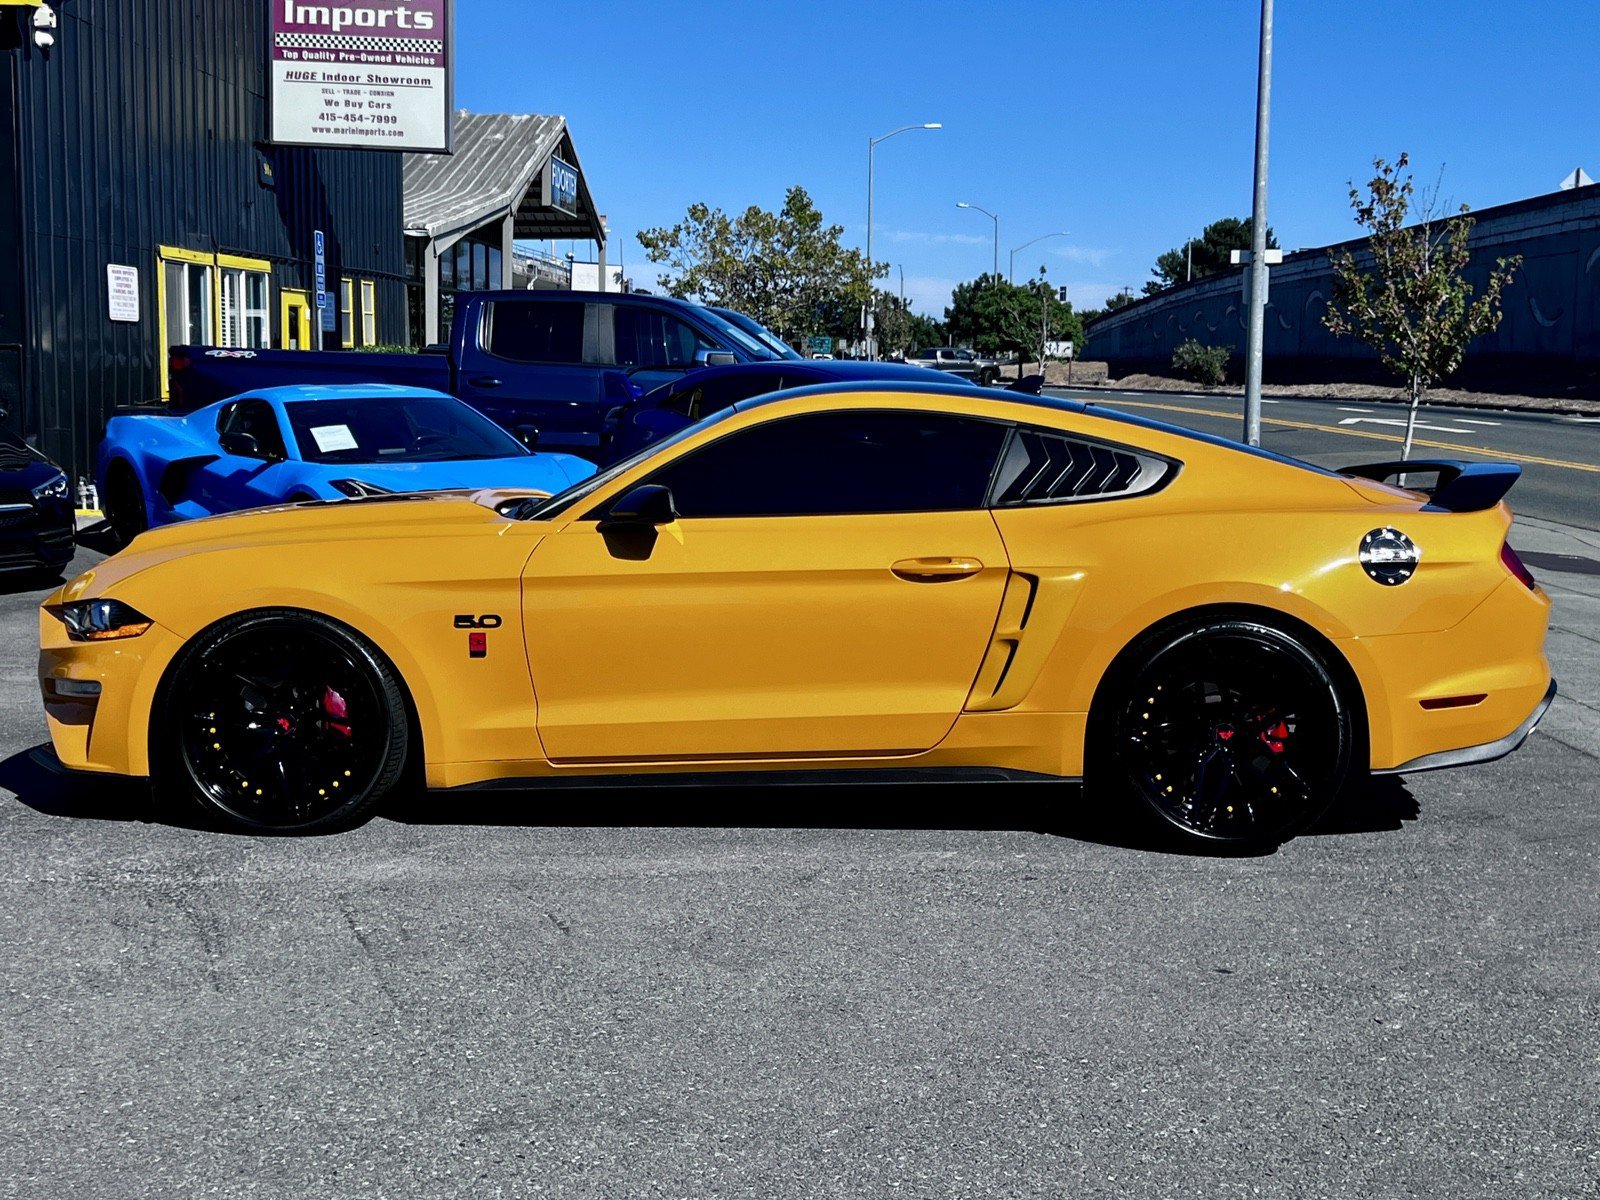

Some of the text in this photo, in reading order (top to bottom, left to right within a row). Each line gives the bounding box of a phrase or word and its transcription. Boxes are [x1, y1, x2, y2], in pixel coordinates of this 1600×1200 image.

[284, 0, 434, 32] Imports
[282, 50, 435, 66] Top Quality Pre-Owned Vehicles
[285, 71, 432, 86] HUGE Indoor Showroom
[324, 99, 392, 109] We Buy Cars
[318, 112, 398, 124] 415-454-7999
